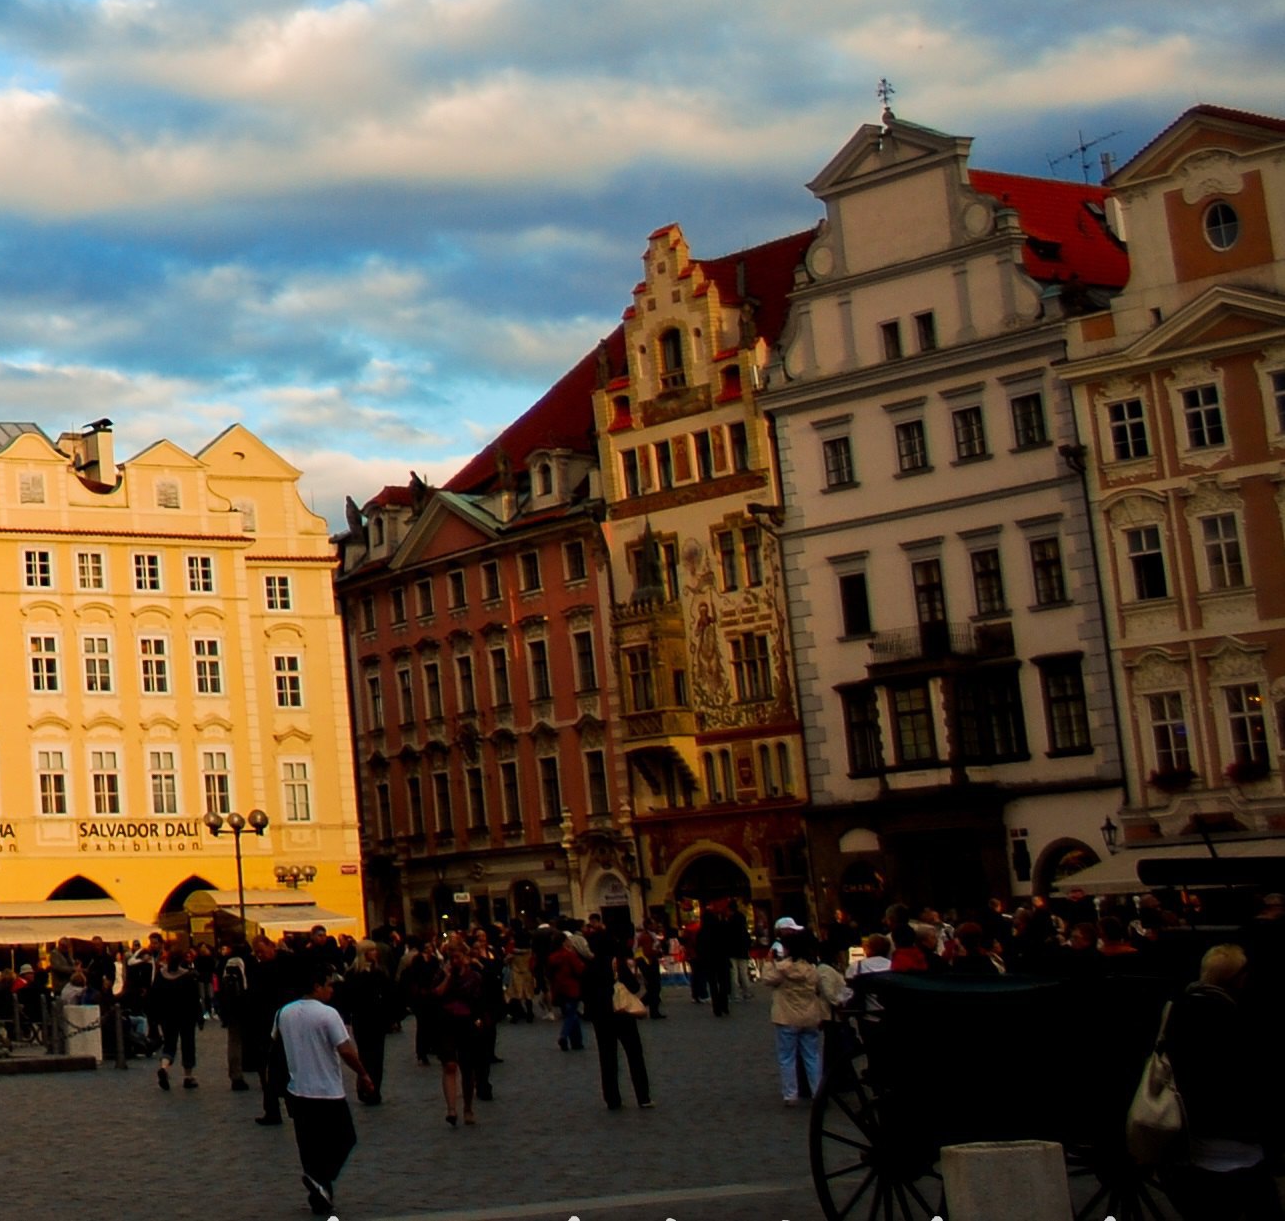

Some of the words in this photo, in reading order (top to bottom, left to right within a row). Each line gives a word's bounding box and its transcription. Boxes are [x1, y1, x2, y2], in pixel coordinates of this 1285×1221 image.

[79, 822, 159, 838] SALVADOR
[165, 818, 199, 837] DALÍ
[81, 840, 200, 852] exhibition
